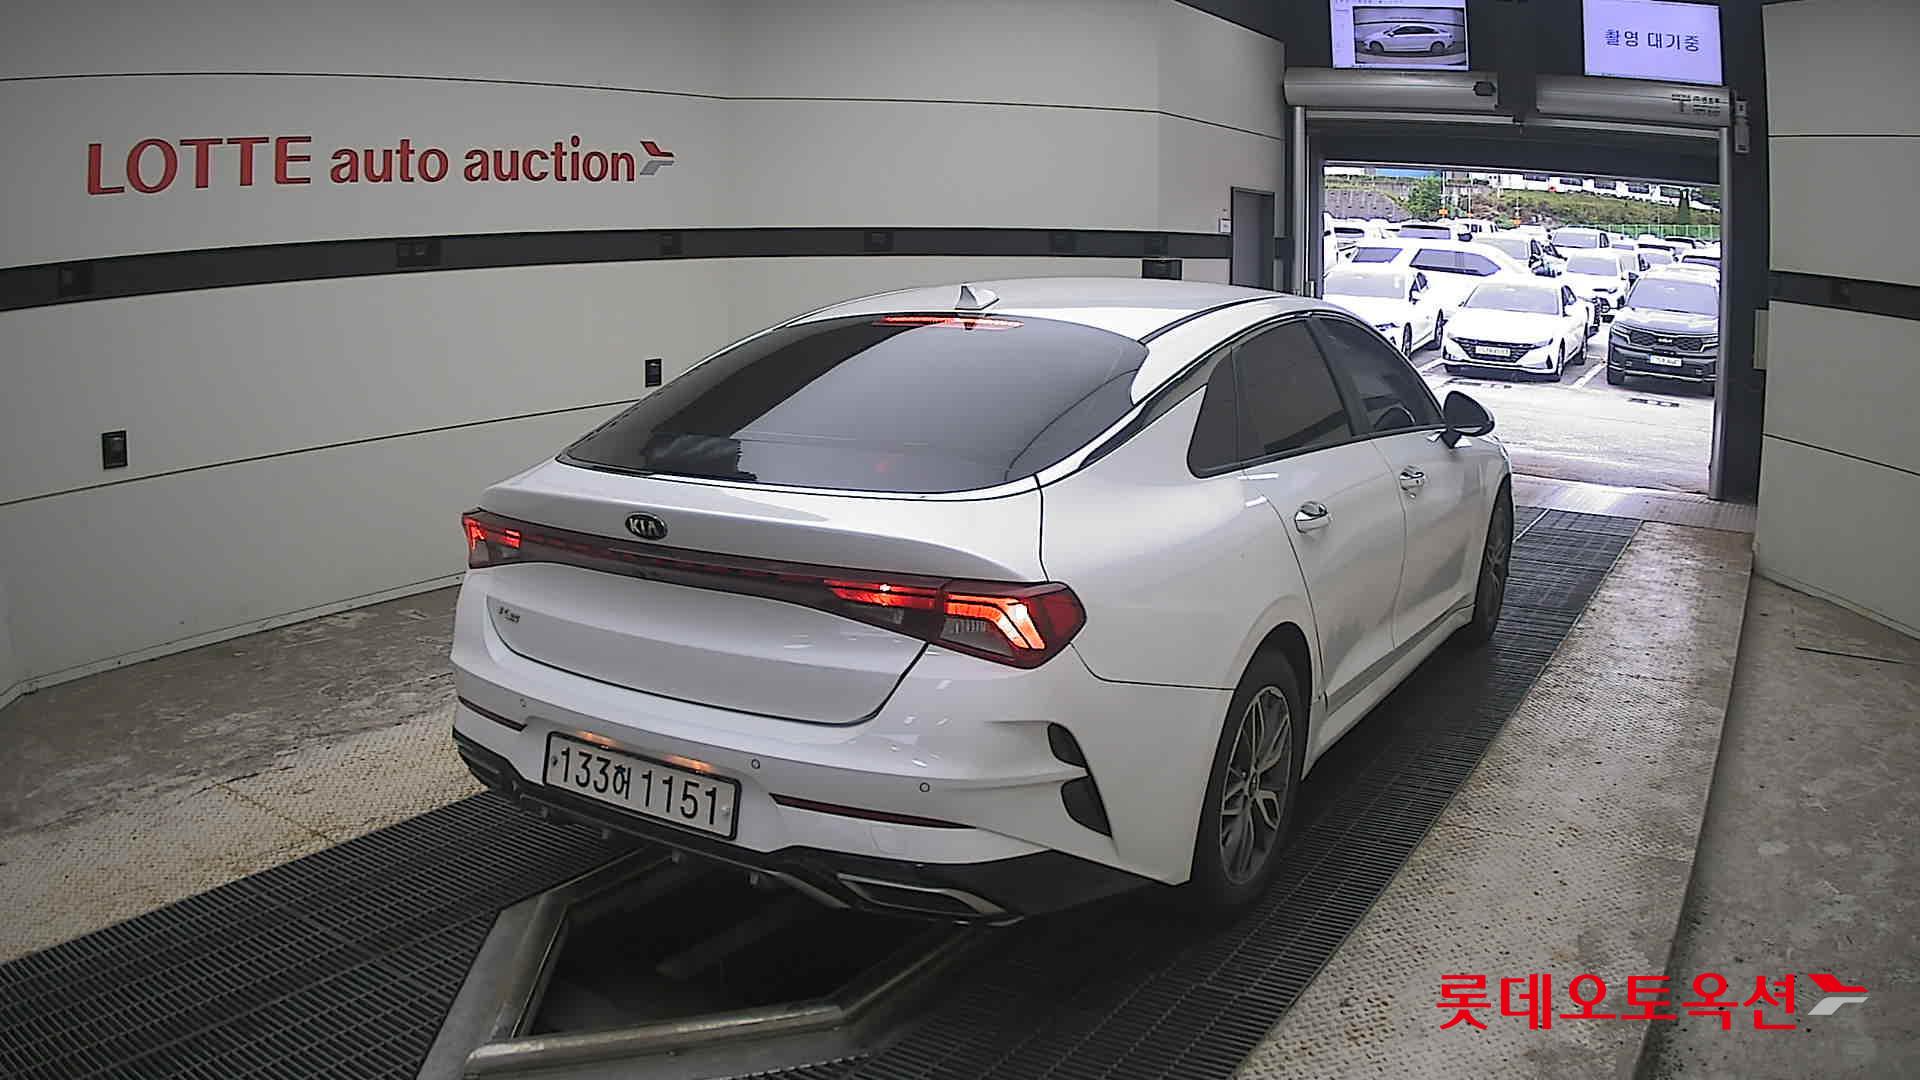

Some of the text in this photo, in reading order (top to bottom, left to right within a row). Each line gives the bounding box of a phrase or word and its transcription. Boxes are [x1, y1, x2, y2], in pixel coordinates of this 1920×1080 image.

[1647, 32, 1700, 52] 대기중
[87, 134, 635, 195] LOTTE auto auction
[628, 518, 658, 534] KIA
[641, 770, 717, 825] 1151
